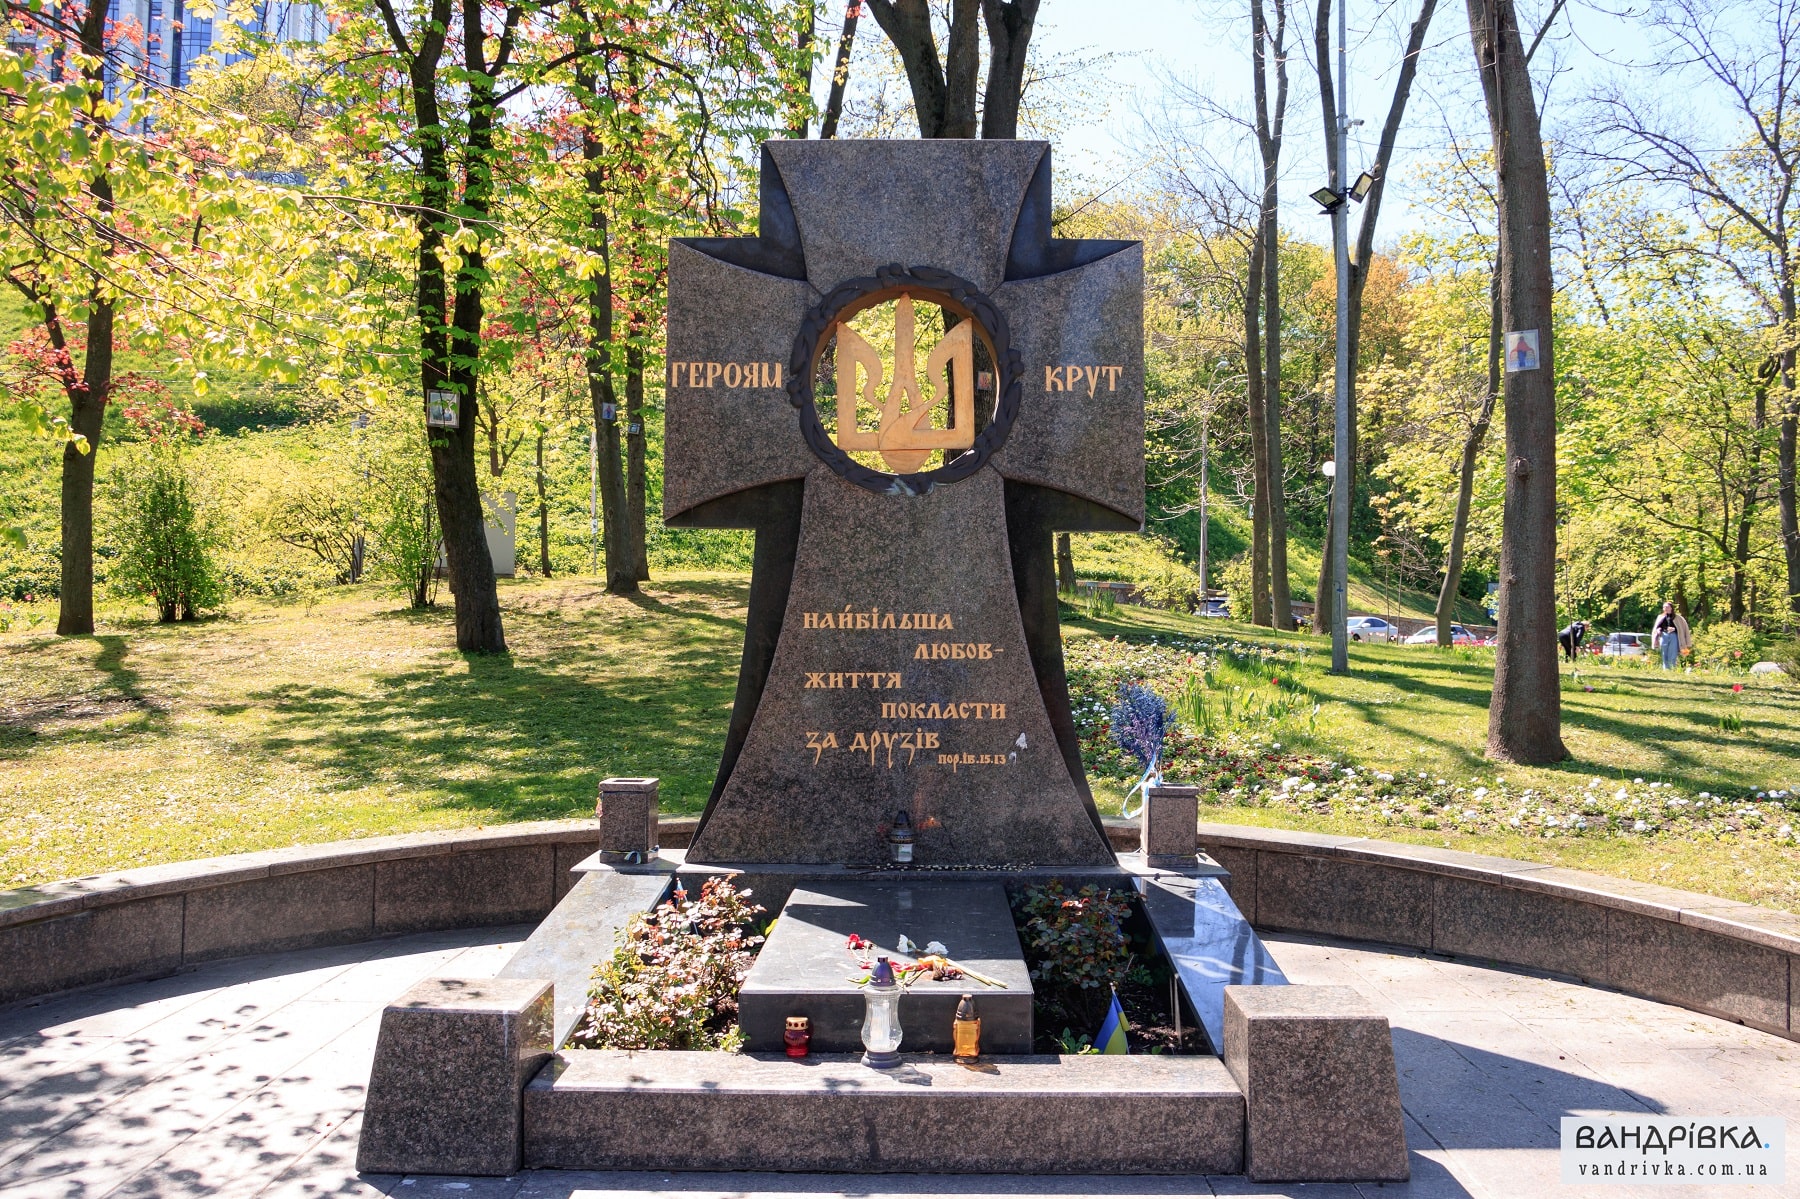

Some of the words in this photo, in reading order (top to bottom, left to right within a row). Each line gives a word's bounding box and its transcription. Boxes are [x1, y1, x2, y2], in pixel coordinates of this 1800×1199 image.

[671, 361, 783, 389] ГЕРОЯМ
[1045, 365, 1124, 399] КРУТ
[803, 604, 954, 630] НАЙБІЛЬША
[804, 672, 902, 689] ЖИТТЯ
[881, 702, 1007, 720] ПОКЛАСТИ
[805, 731, 839, 766] ЗА
[849, 727, 941, 769] ДРУЗІВ
